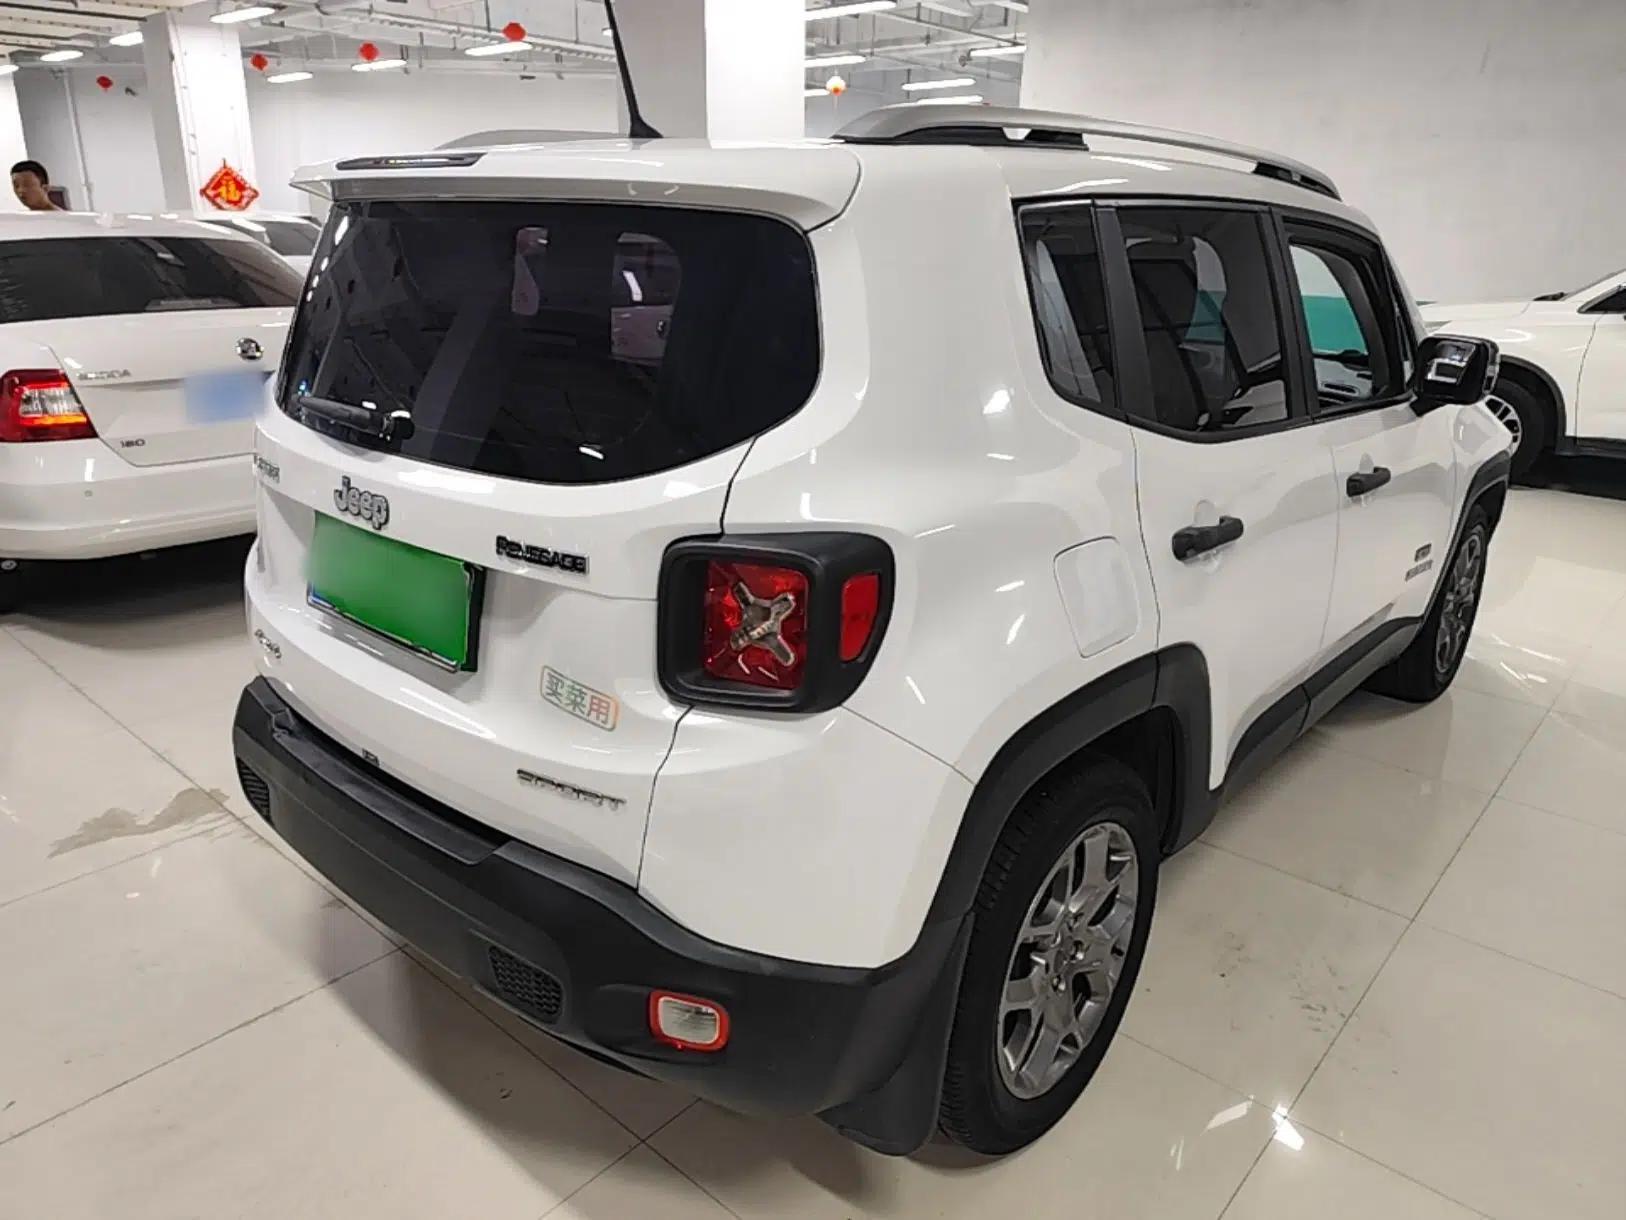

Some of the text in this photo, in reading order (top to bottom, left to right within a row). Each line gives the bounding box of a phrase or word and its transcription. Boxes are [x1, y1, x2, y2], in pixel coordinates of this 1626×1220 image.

[333, 475, 390, 531] Jeep
[495, 534, 589, 575] RENEGADE
[546, 671, 610, 725] 买菜用
[516, 768, 627, 811] SPORT
